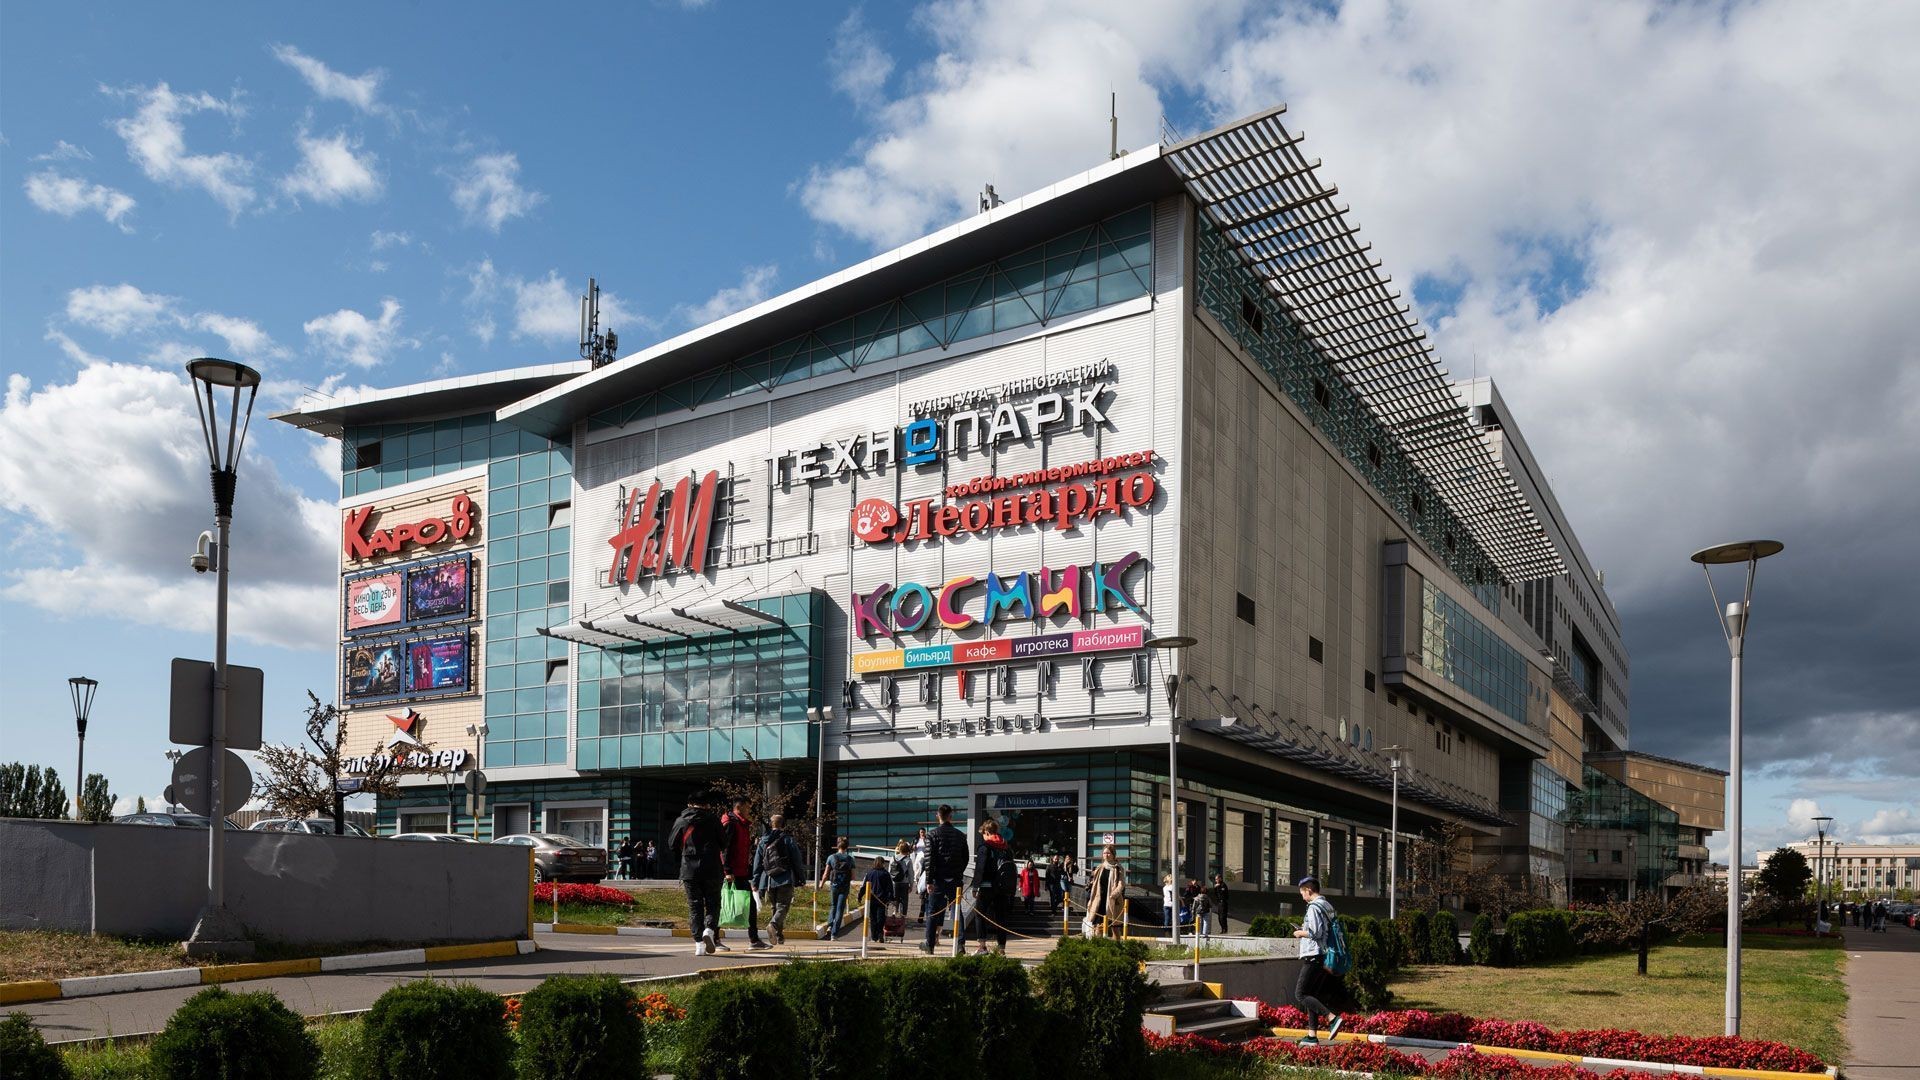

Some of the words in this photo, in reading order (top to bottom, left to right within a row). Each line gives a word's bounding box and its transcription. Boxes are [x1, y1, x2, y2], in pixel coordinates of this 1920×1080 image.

[908, 387, 989, 417] КУЛЬТУРА
[1000, 358, 1110, 398] ИННОВАЦИЙ
[766, 383, 1106, 485] ТЕХНОПАРК
[945, 450, 1154, 497] хобби-гипермаркет
[451, 494, 471, 539] 8
[608, 470, 719, 584] H&M
[895, 472, 1155, 543] Леонардо
[353, 593, 370, 604] КИНО
[371, 591, 380, 601] ОТ
[380, 589, 392, 600] 250
[353, 605, 369, 615] ВЕСЬ
[369, 602, 387, 614] ДЕНЬ
[852, 551, 1142, 640] КОСМИК
[858, 654, 900, 668] боулинг
[906, 650, 950, 664] бильярд
[966, 644, 997, 658] кафе
[1015, 637, 1069, 656] игротека
[1077, 631, 1138, 647] лабиринт
[924, 712, 1042, 735] SEAFOOD
[1007, 797, 1038, 806] Villeroy
[1048, 795, 1069, 804] Boch
